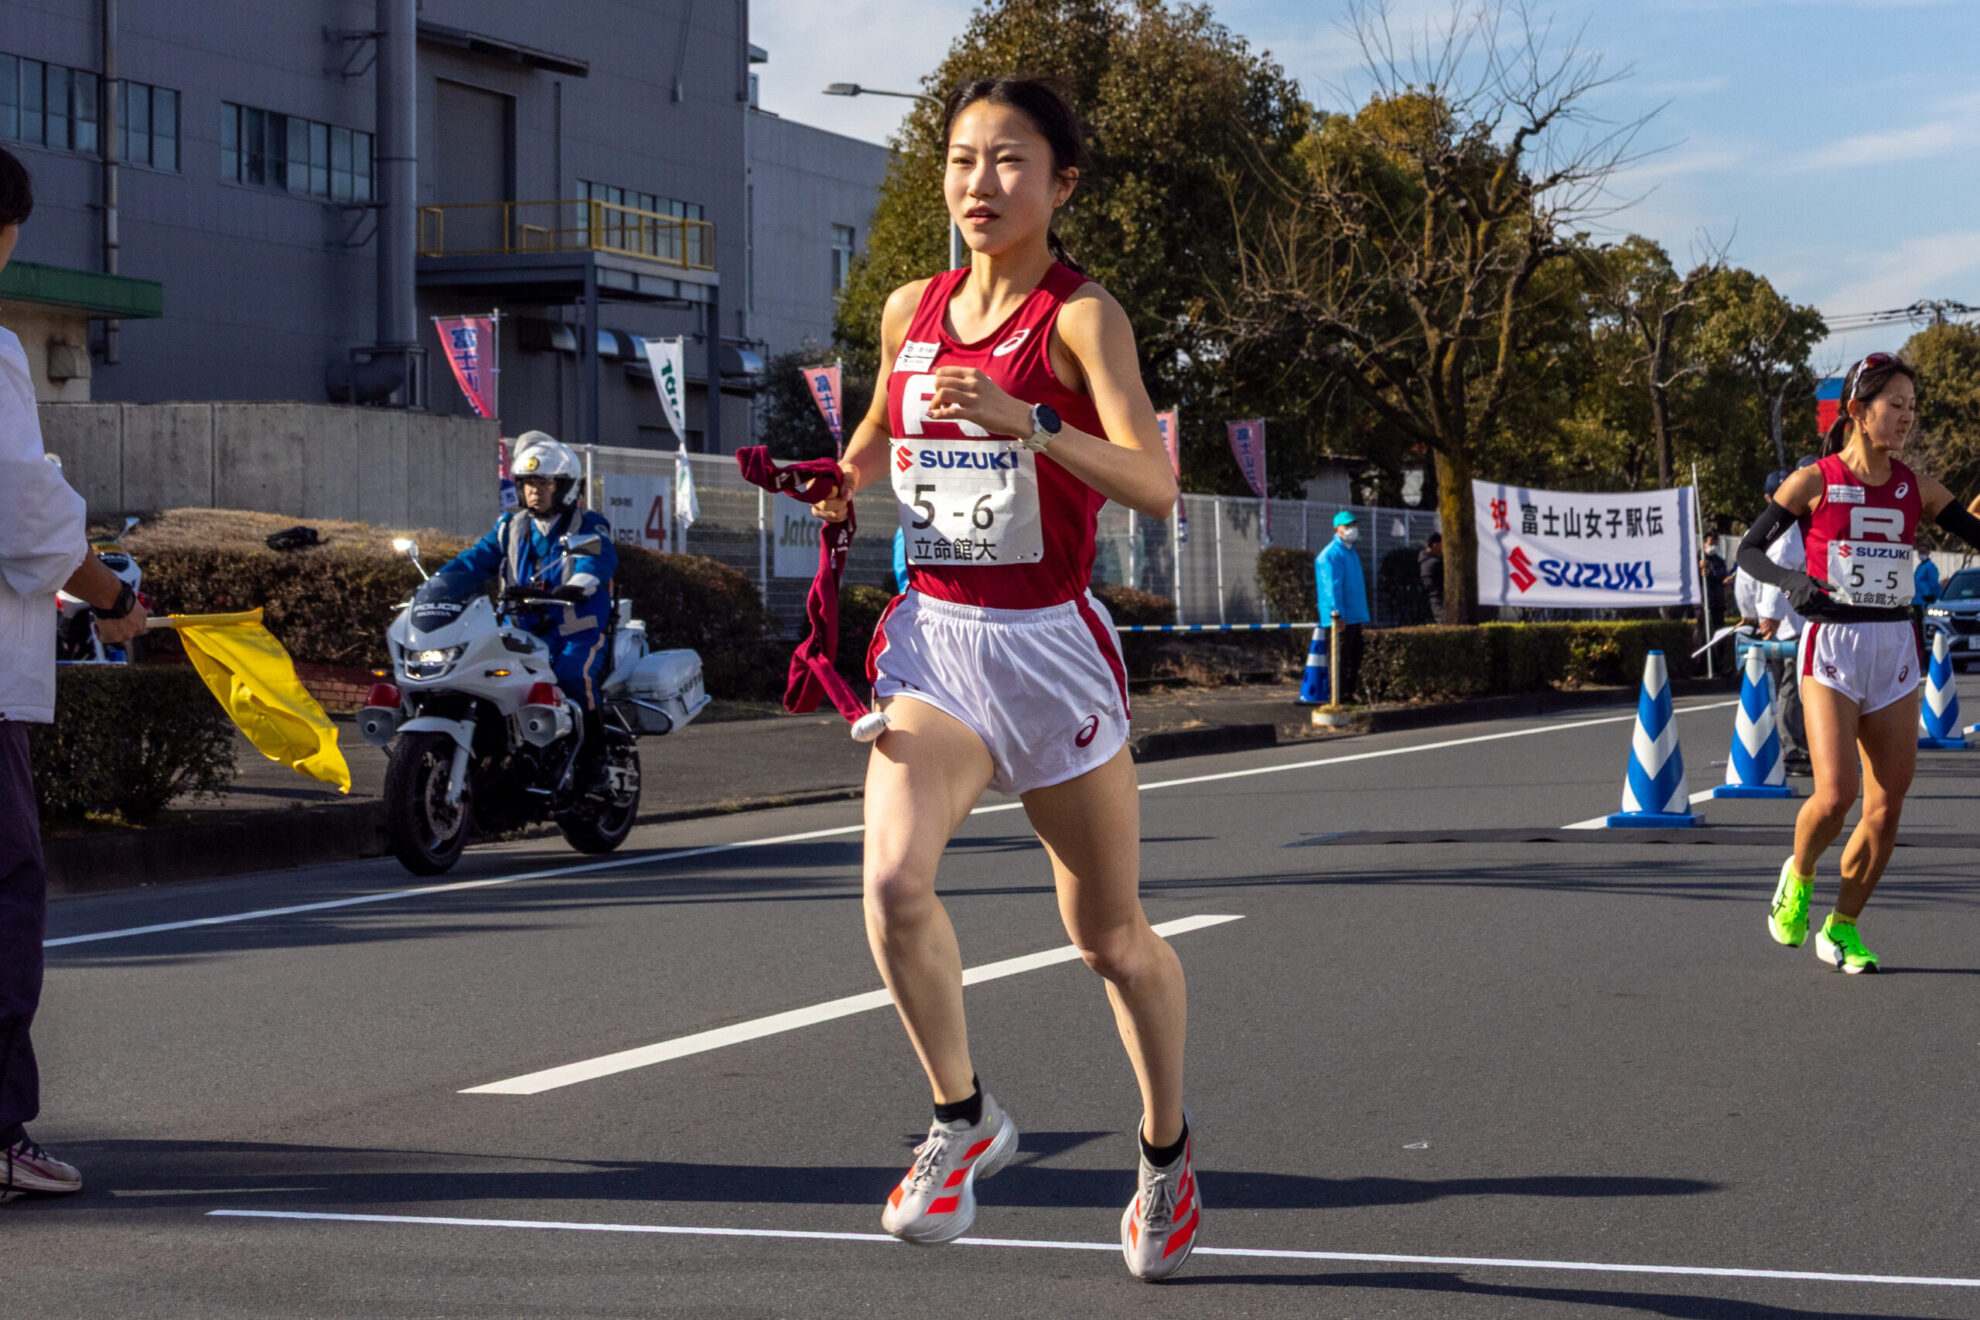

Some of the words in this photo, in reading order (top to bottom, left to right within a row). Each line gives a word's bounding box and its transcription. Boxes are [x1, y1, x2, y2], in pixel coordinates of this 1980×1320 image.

[919, 449, 1019, 471] SUZUKI
[645, 495, 667, 551] 4
[1490, 497, 1511, 531] 祝
[1520, 502, 1664, 539] 富士山女子駅伝
[1850, 506, 1905, 542] R
[914, 537, 997, 561] 立命館大
[1855, 546, 1910, 561] SUZUKI
[1538, 559, 1654, 590] SUZUKI
[413, 602, 462, 612] POLICE
[1852, 592, 1897, 606] 立命館大
